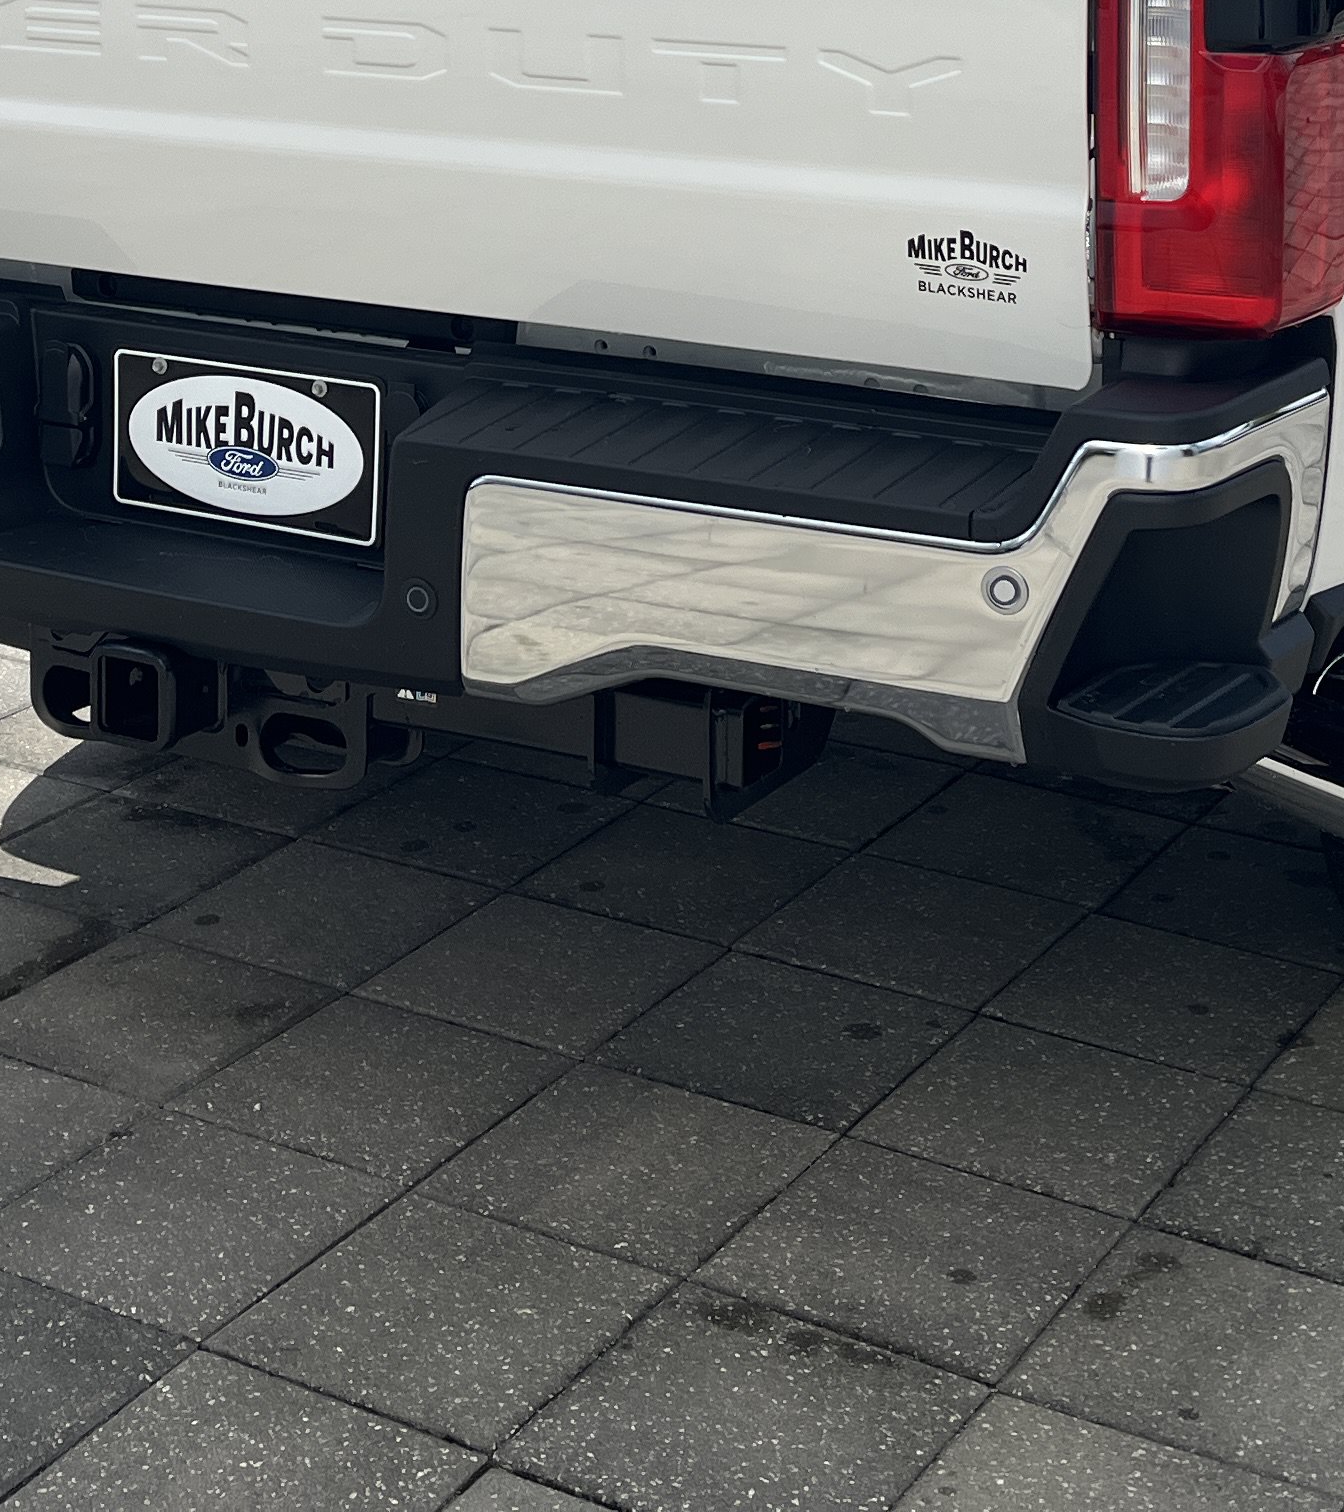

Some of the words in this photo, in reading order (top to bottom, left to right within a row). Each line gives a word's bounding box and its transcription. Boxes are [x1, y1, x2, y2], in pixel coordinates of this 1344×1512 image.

[323, 16, 962, 117] DUTY
[953, 265, 981, 279] Ford
[918, 280, 1017, 304] BLACKSHEAR
[220, 451, 265, 477] Ford
[218, 480, 267, 495] BLACKSHEAR
